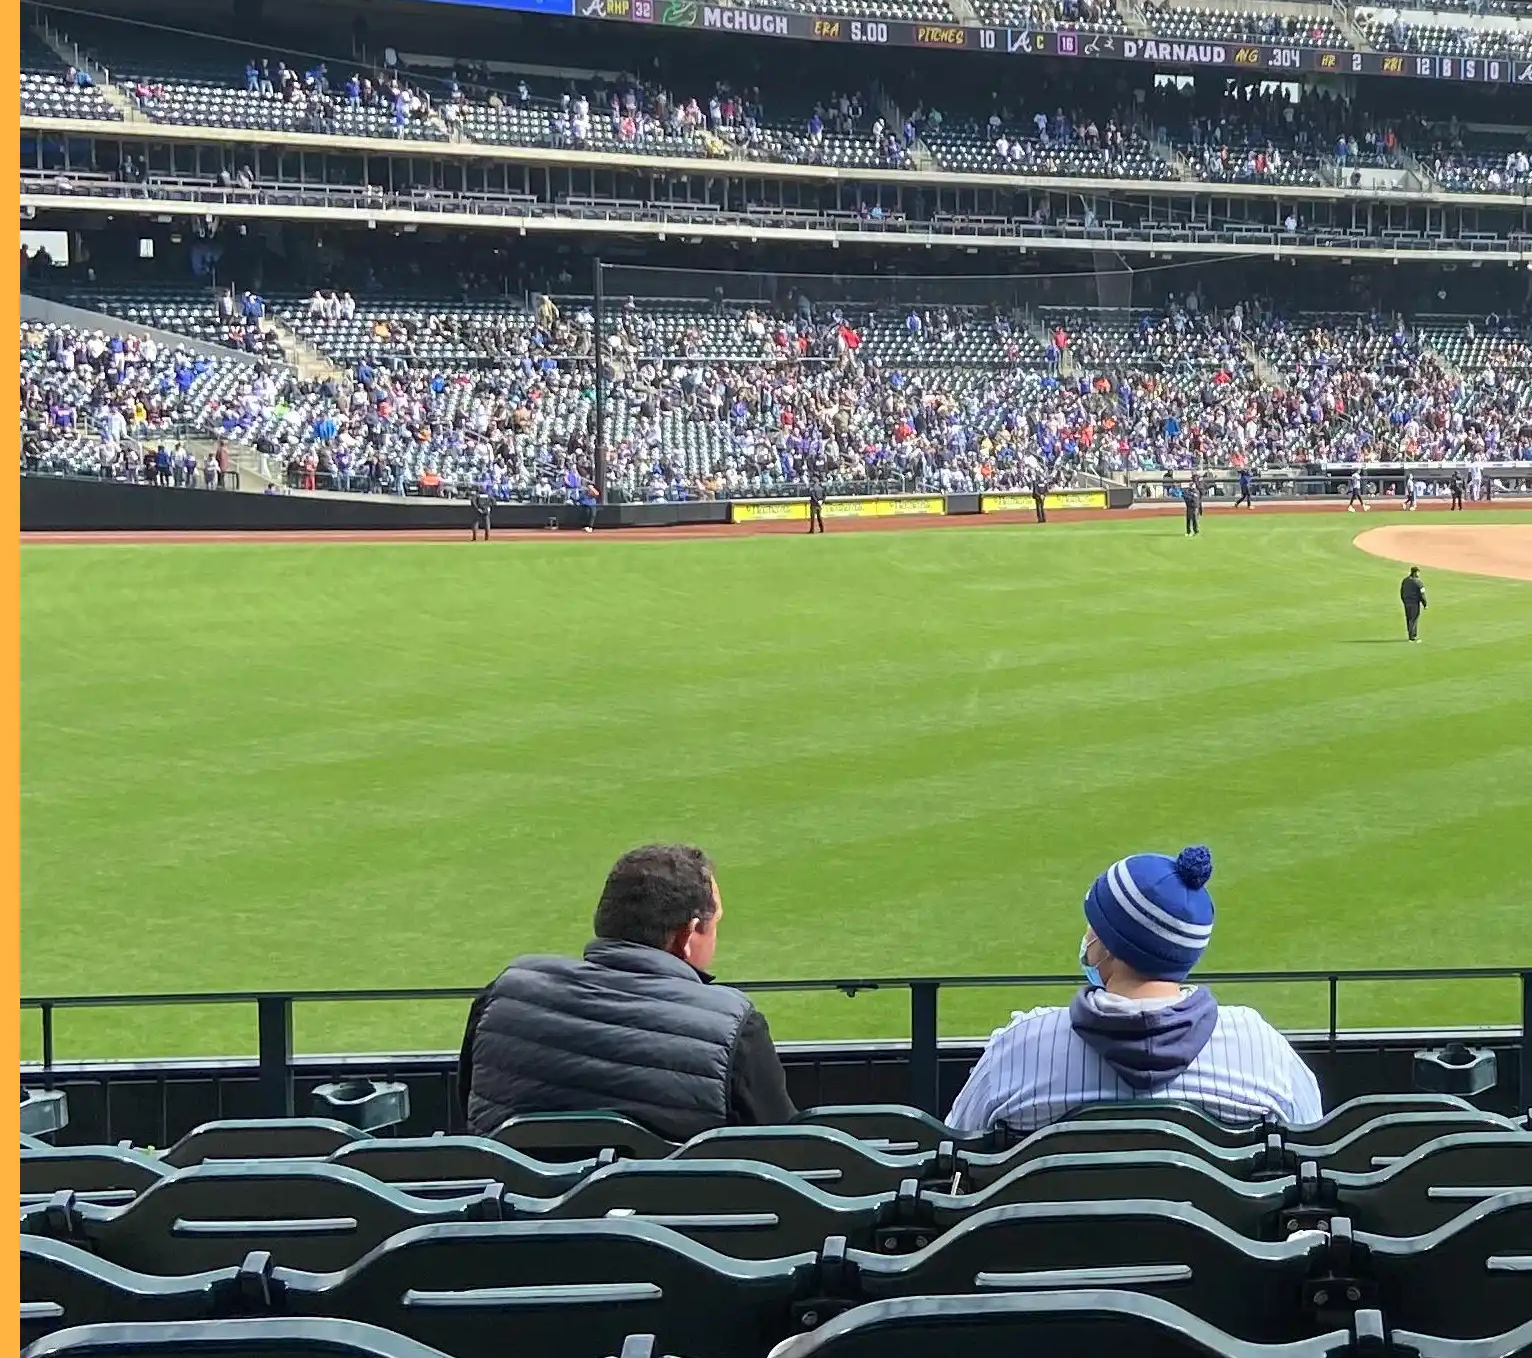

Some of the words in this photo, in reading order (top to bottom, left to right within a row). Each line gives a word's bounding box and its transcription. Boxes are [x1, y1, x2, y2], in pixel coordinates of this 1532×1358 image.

[606, 0, 630, 14] RHP
[635, 2, 651, 18] 32
[814, 20, 841, 37] ERA
[851, 21, 888, 42] 5.00
[916, 27, 964, 44] PITCHES
[980, 29, 996, 49] 10
[1036, 35, 1045, 50] C
[1124, 39, 1225, 62] D'ARNAUD
[1268, 48, 1300, 68] .304
[1352, 53, 1362, 71] 2
[1416, 57, 1430, 75] 12
